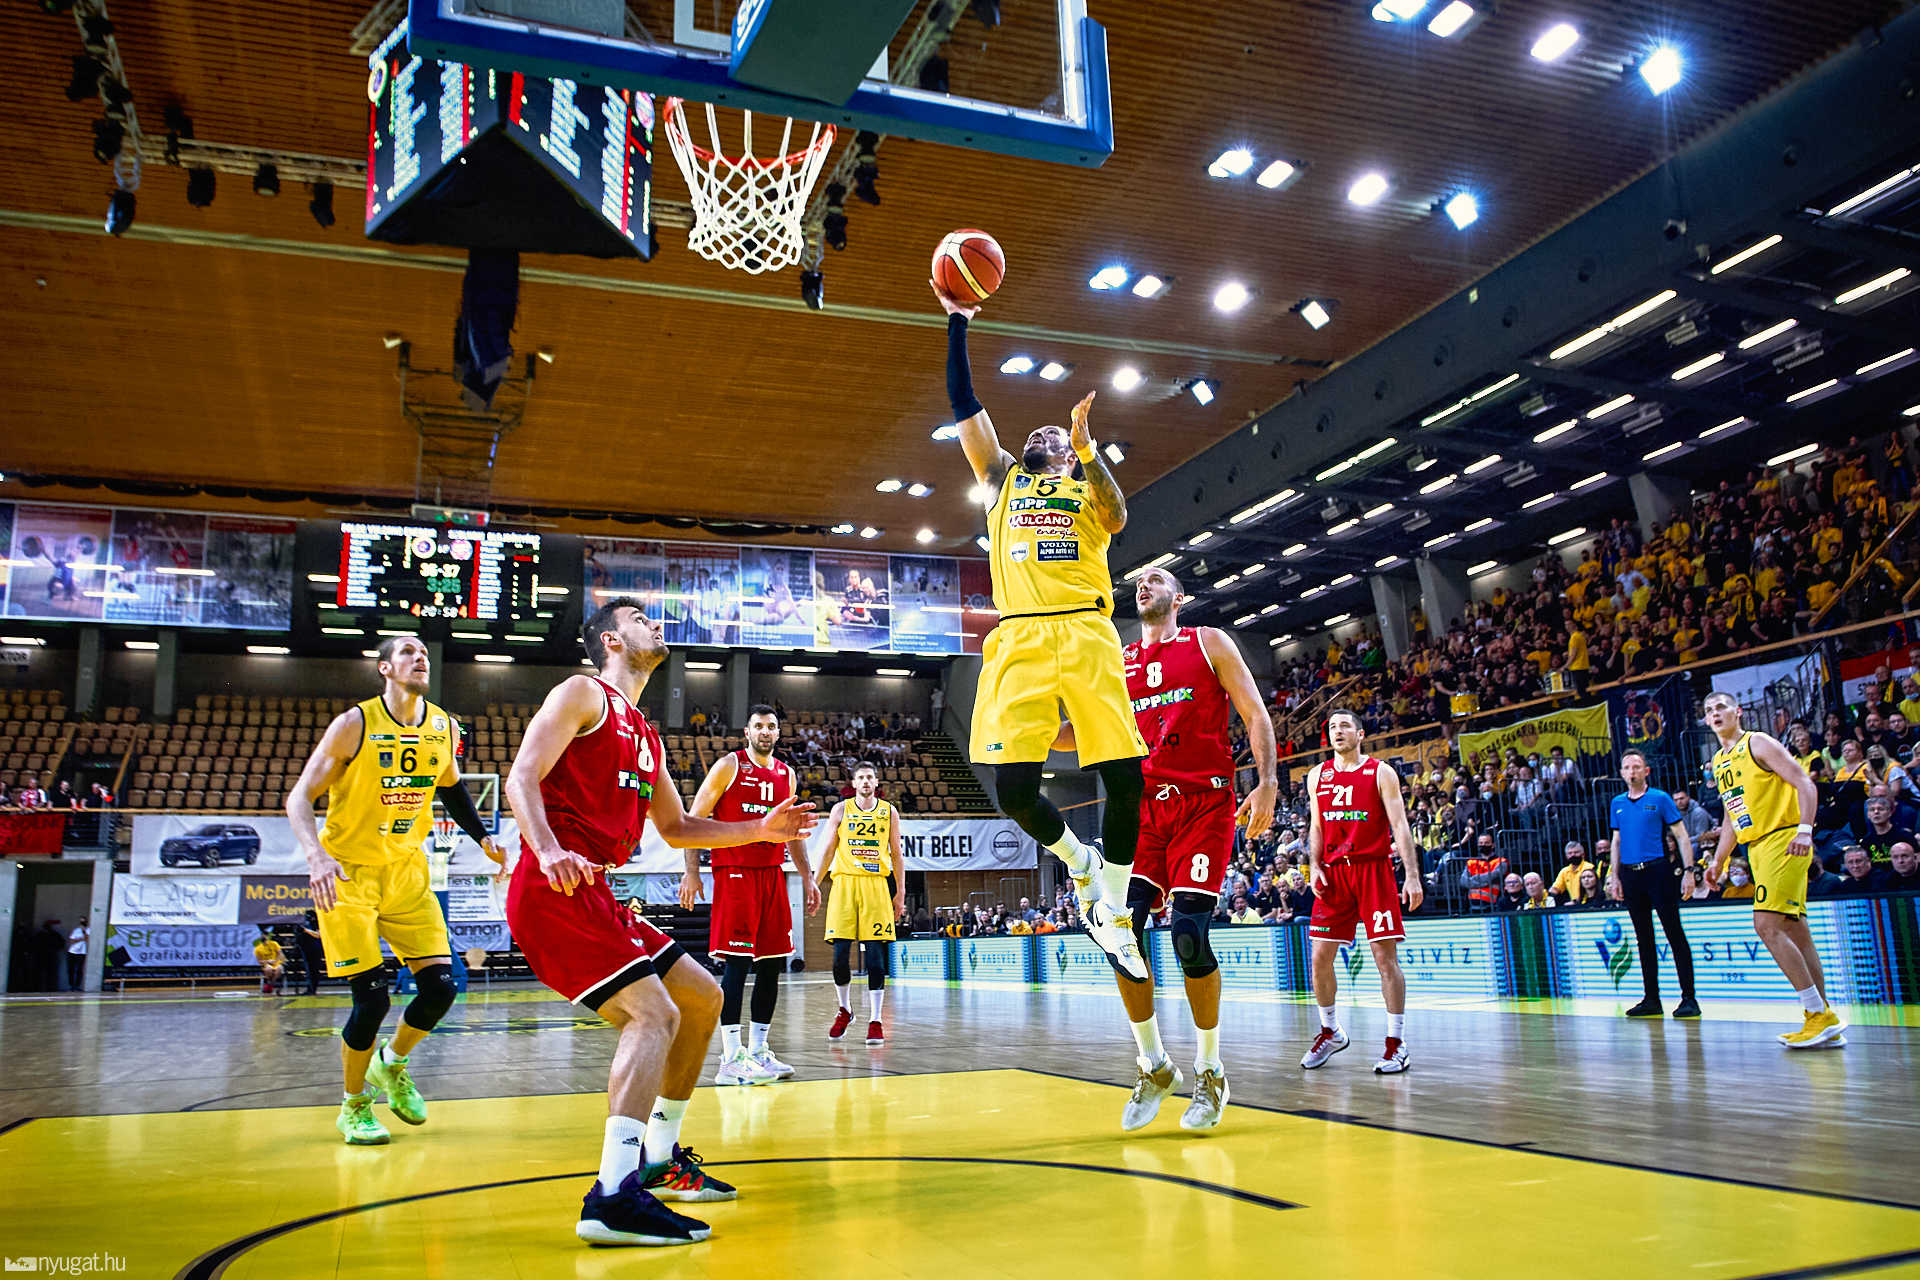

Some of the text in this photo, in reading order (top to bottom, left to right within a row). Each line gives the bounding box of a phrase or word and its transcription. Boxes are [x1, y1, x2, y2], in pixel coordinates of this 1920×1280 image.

[1036, 479, 1057, 497] 5
[1037, 529, 1078, 539] energia
[1146, 662, 1163, 688] 8
[400, 748, 417, 773] 6
[1720, 769, 1734, 789] 10
[381, 792, 426, 805] VULCAN
[758, 781, 774, 801] 11
[1332, 785, 1354, 806] 21
[857, 822, 878, 836] 24
[931, 835, 973, 858] BELE!
[1191, 853, 1209, 882] 8
[873, 923, 893, 936] 24
[1373, 910, 1394, 933] 21
[140, 948, 243, 961] grafikai studió
